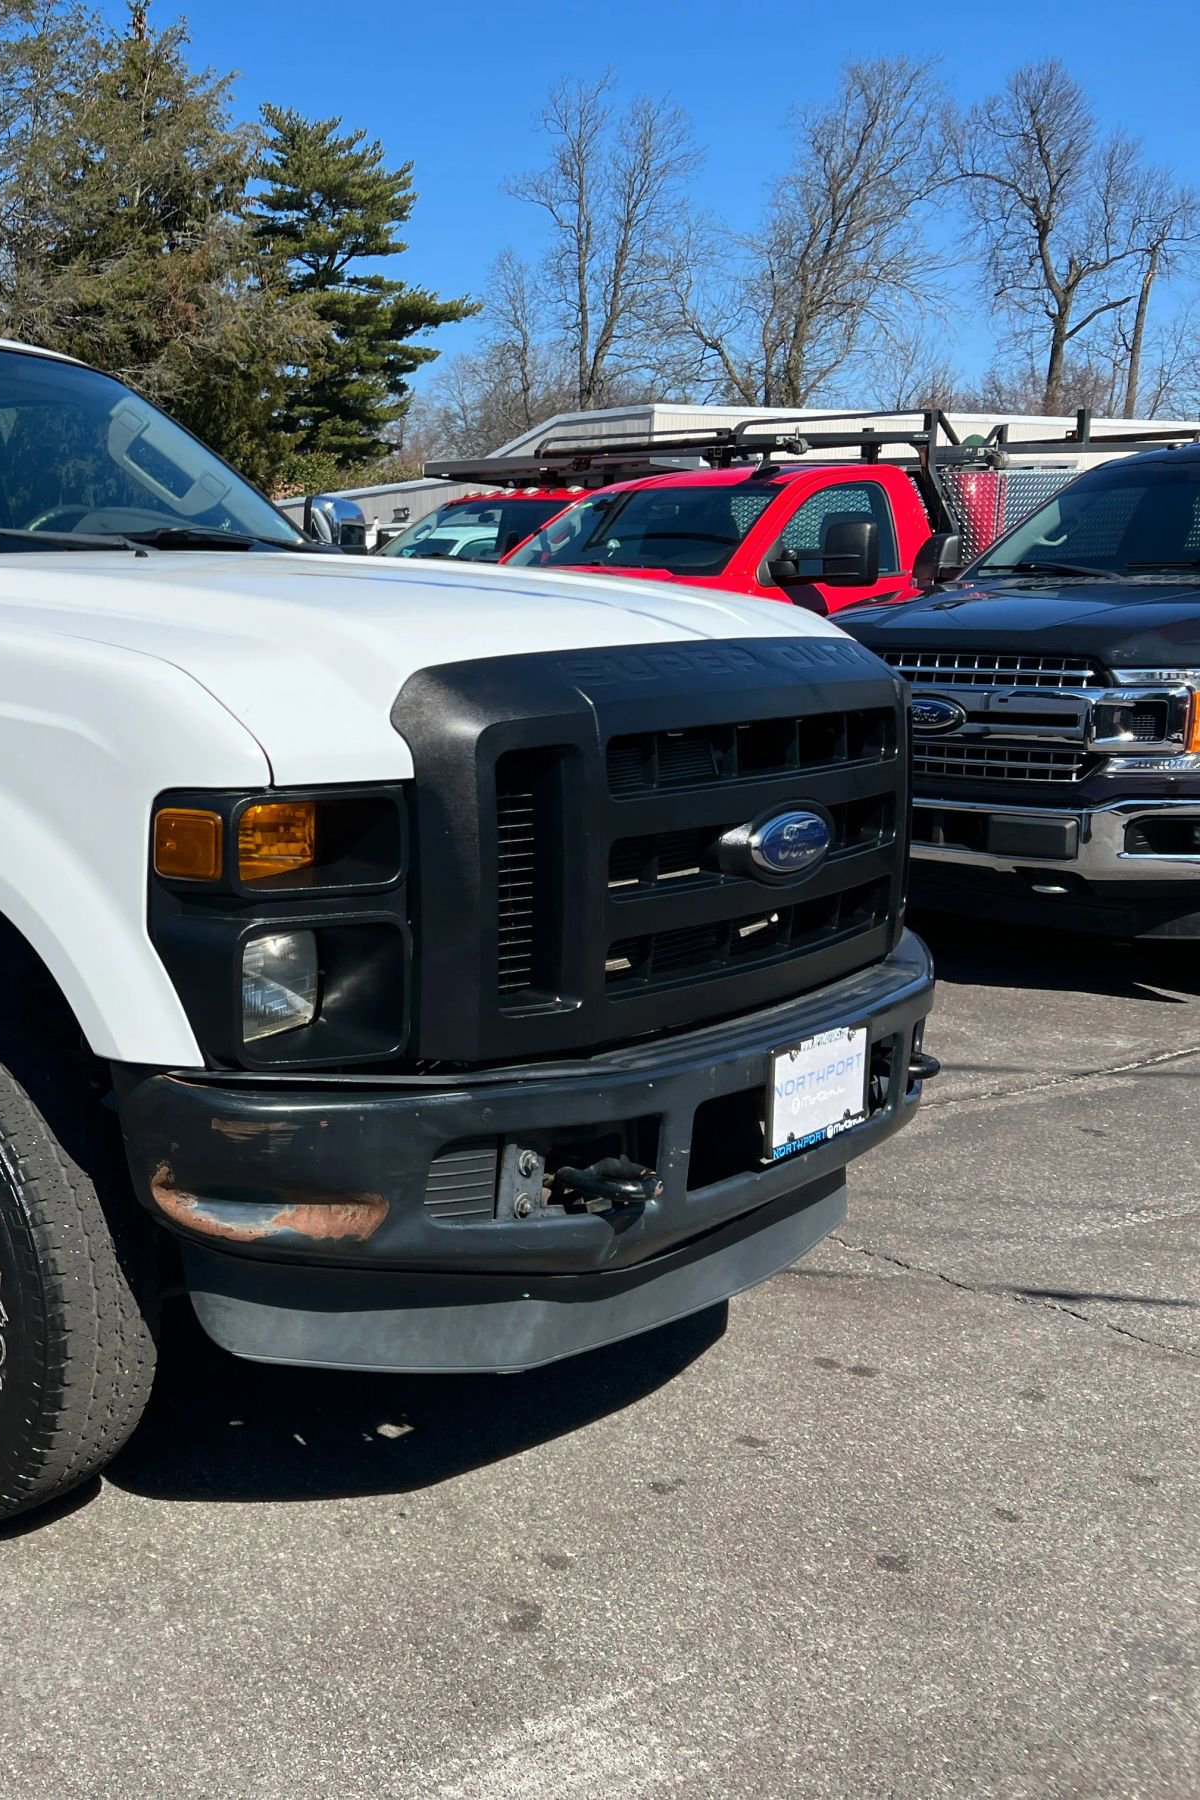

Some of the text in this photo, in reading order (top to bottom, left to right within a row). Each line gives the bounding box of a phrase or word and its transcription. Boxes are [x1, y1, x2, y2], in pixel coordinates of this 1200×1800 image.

[557, 644, 872, 687] SUPER DUTY
[775, 1052, 863, 1099] NORTHPORT
[772, 1129, 826, 1160] NORTHPORT
